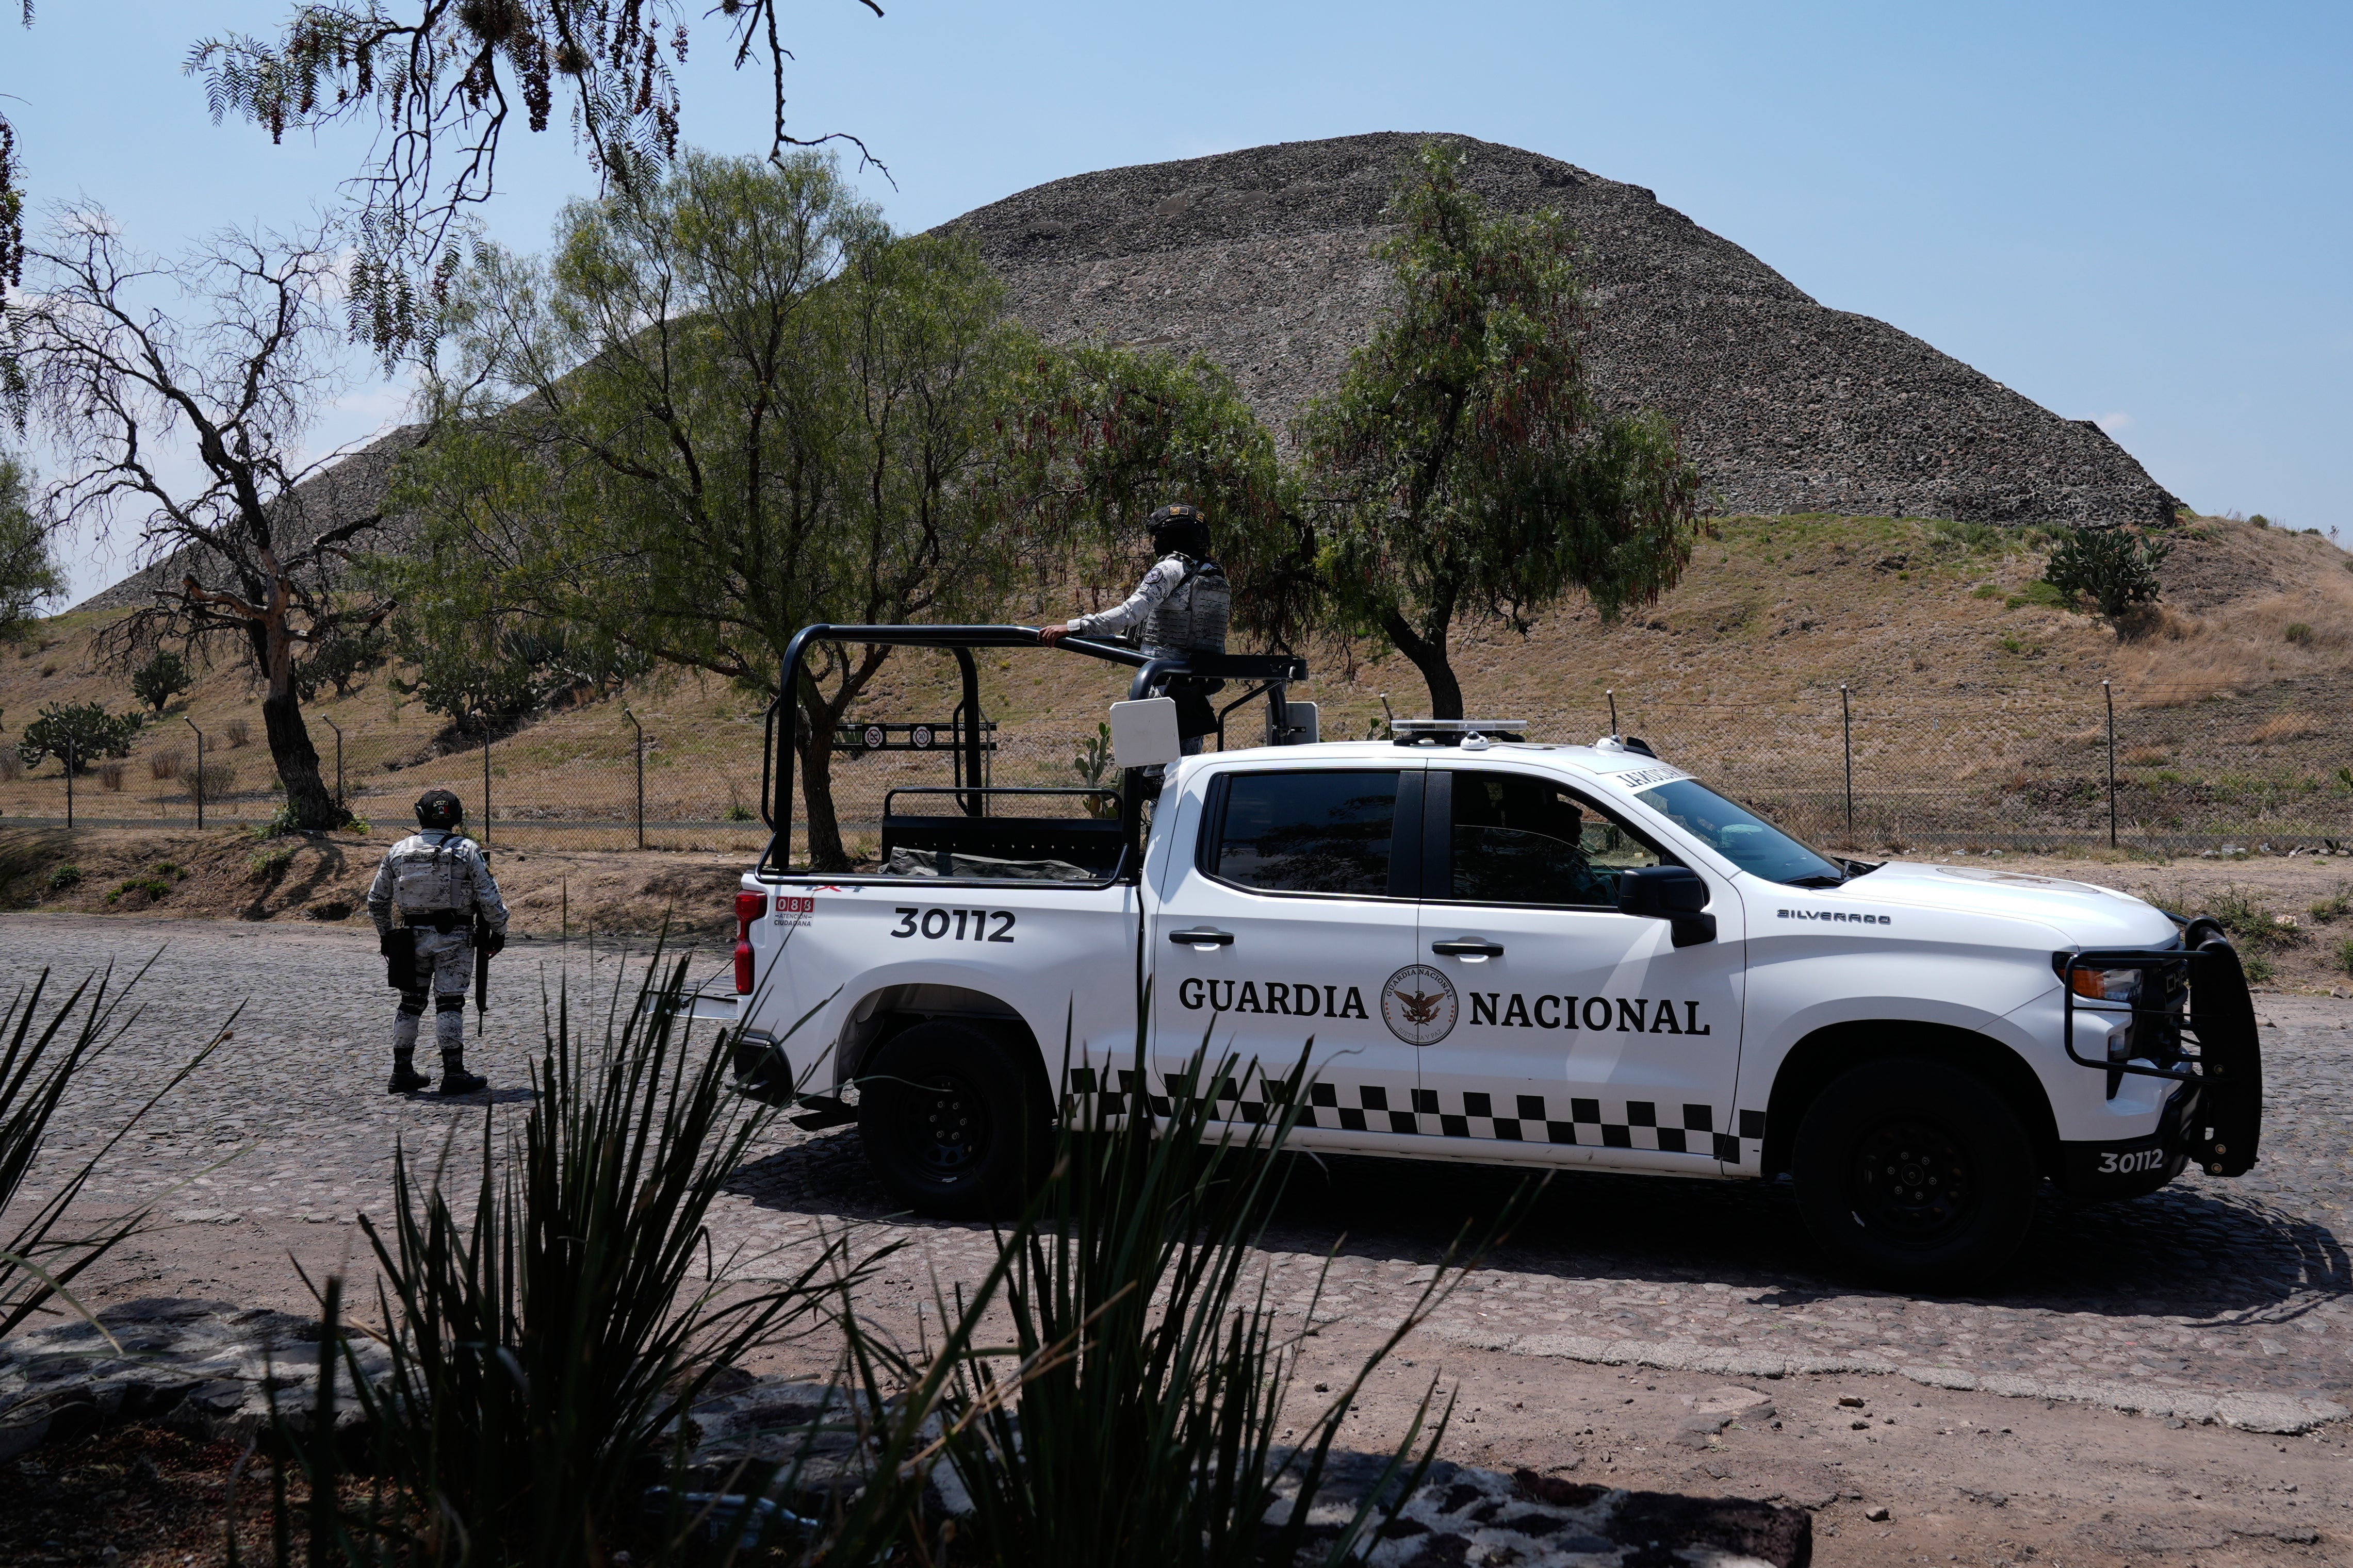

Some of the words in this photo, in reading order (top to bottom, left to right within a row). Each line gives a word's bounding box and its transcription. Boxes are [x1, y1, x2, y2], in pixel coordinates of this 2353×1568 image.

[778, 898, 811, 912] 088
[1777, 909, 1891, 925] SILVERADO
[890, 907, 1016, 943] 30112
[1386, 969, 1417, 997] GUARDIA
[1418, 968, 1453, 1000] NACIONAL
[1179, 978, 1369, 1020] GUARDIA
[1469, 992, 1710, 1036] NACIONAL
[1397, 1027, 1425, 1041] JUSTICA
[1430, 1029, 1443, 1038] PAZ
[2097, 1148, 2163, 1174] 30112
